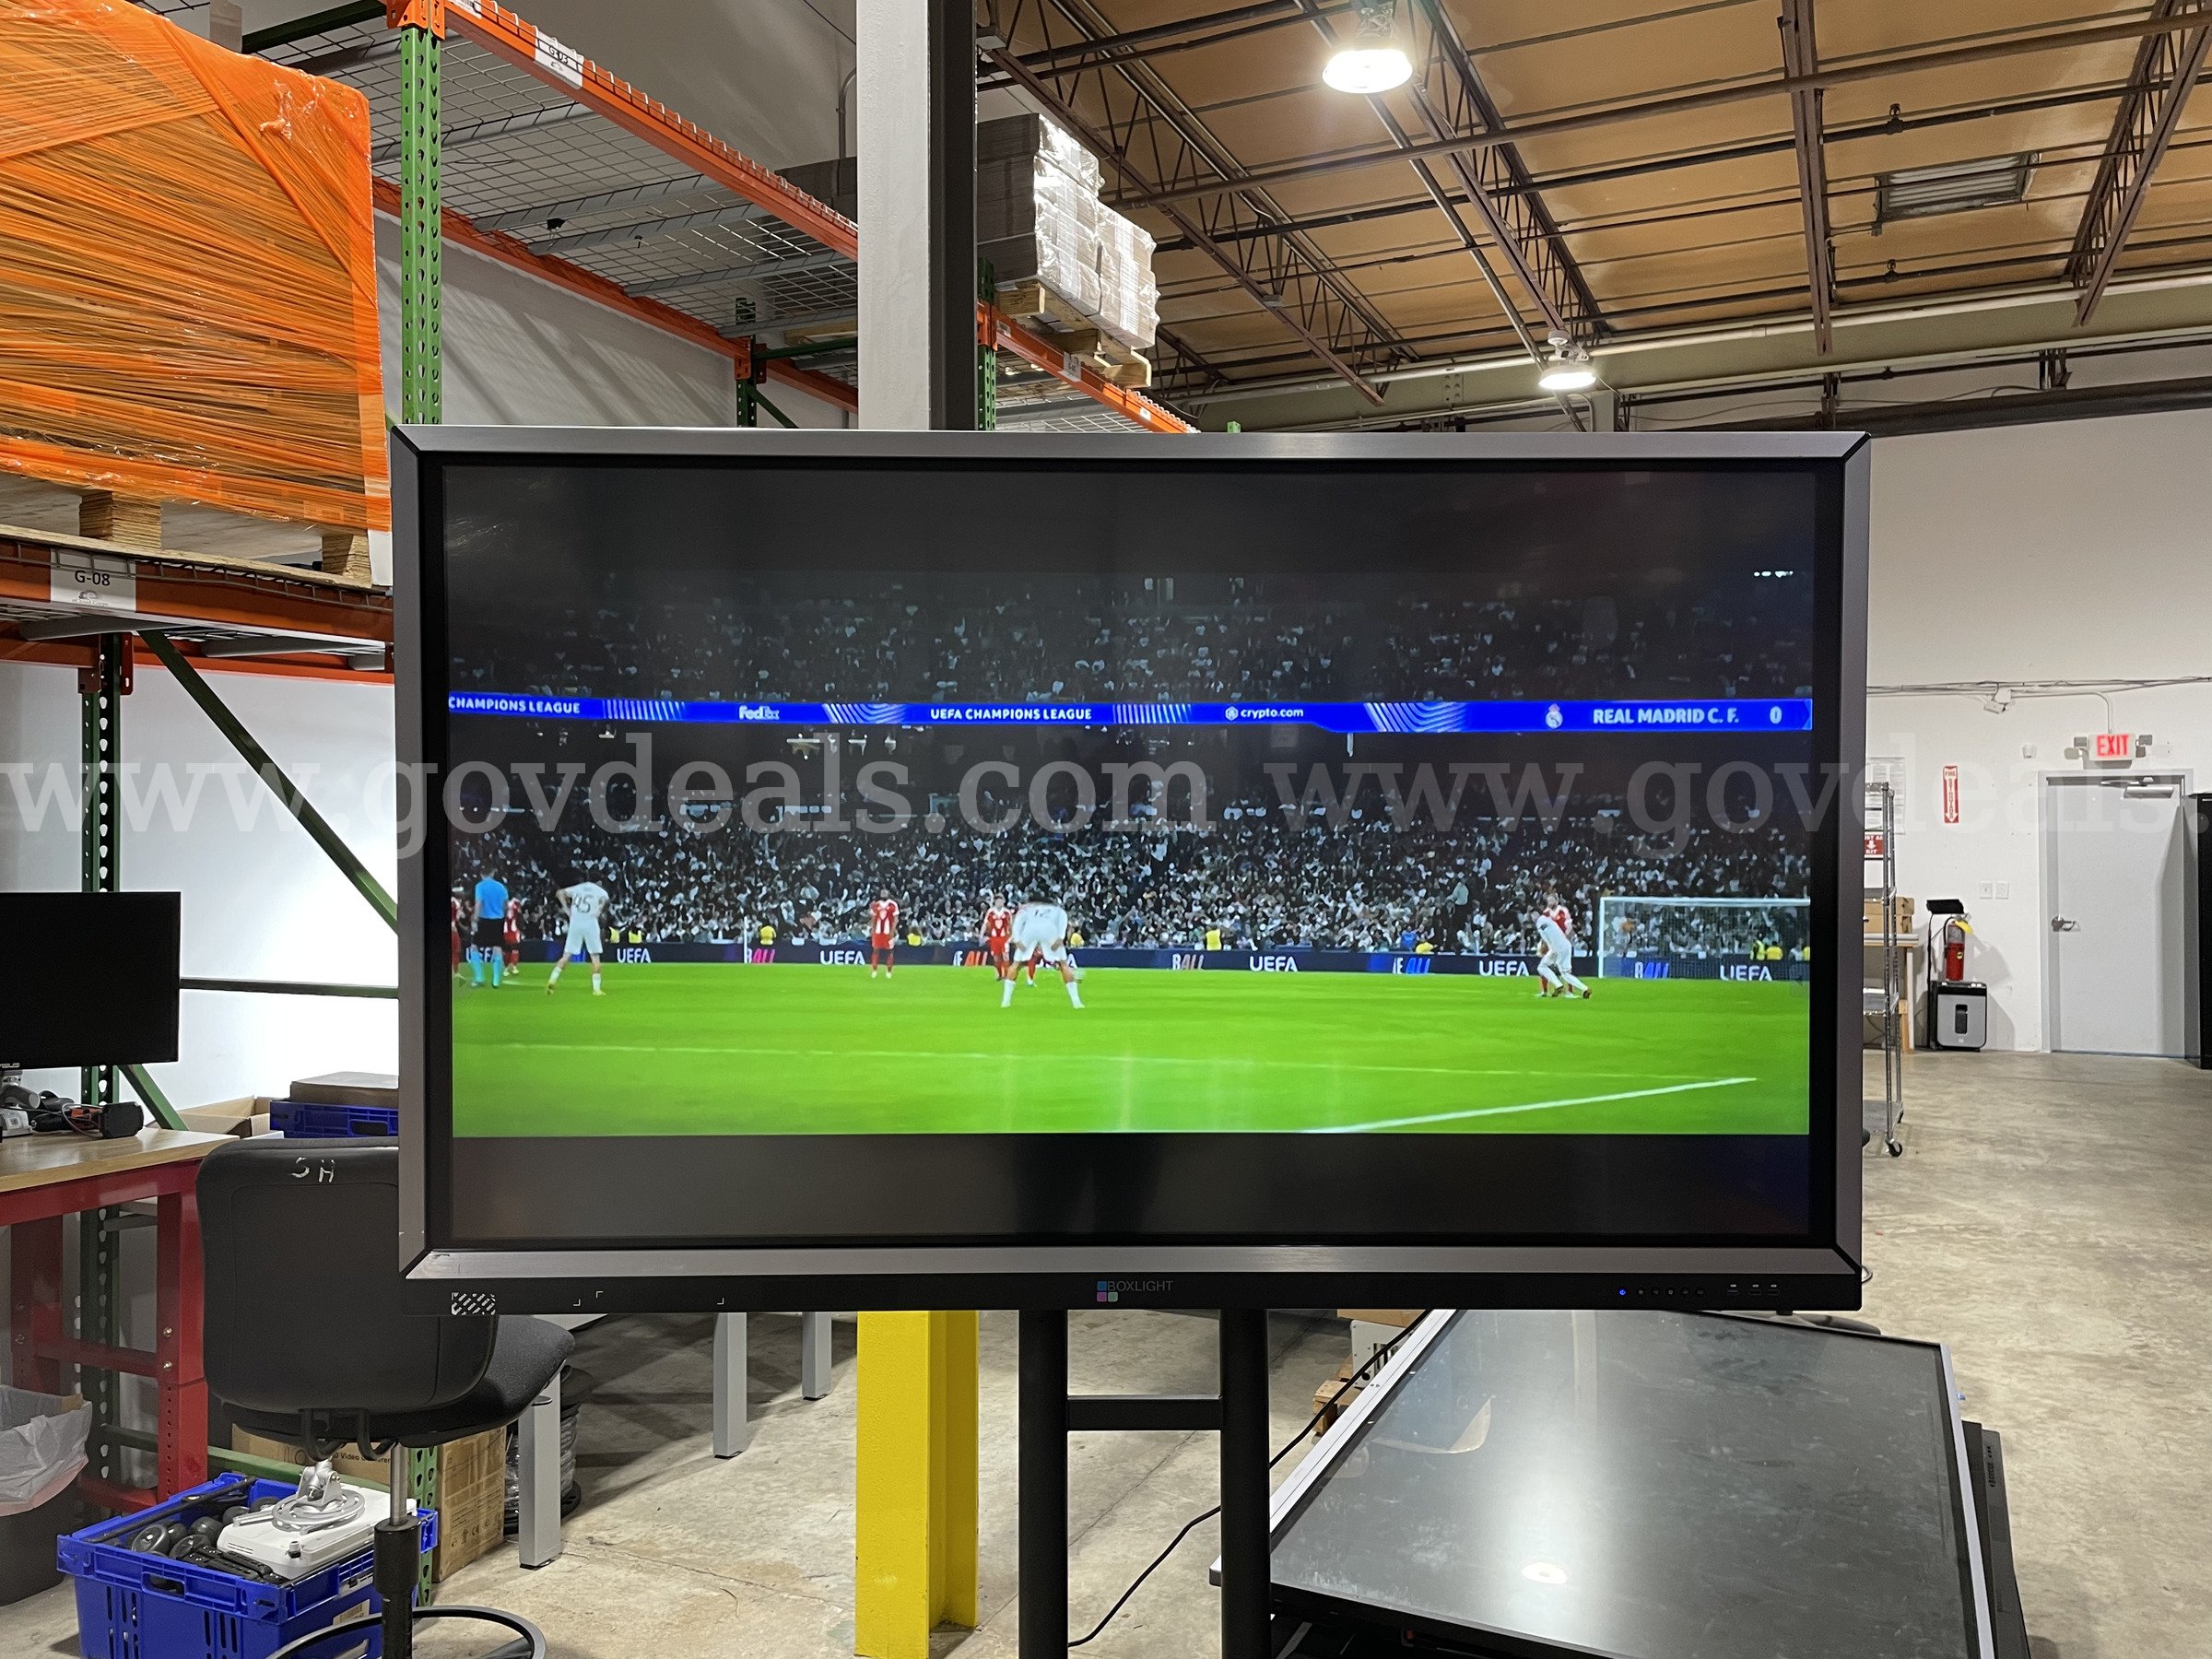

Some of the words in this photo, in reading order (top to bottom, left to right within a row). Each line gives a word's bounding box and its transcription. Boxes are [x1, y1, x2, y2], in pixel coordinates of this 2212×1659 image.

[75, 570, 111, 586] G-08
[448, 696, 526, 712] CHAMPIONS
[528, 700, 581, 714] LEAGUE
[1241, 707, 1304, 720] crypto.com
[930, 708, 962, 720] UEFA
[965, 708, 1041, 720] CHAMPIONS
[1043, 708, 1092, 720] LEAGUE
[1593, 708, 1635, 724] REAL
[1638, 707, 1705, 724] MADRID
[1769, 705, 1783, 724] 0
[2096, 734, 2129, 757] EXIT
[617, 947, 652, 964] UEFA
[819, 950, 866, 965] UEFA
[1249, 955, 1299, 972] UEFA
[1478, 959, 1530, 977] UEFA
[1719, 964, 1773, 982] UEFA
[1107, 1280, 1174, 1292] BOXLIGHT
[340, 1452, 359, 1461] Video
